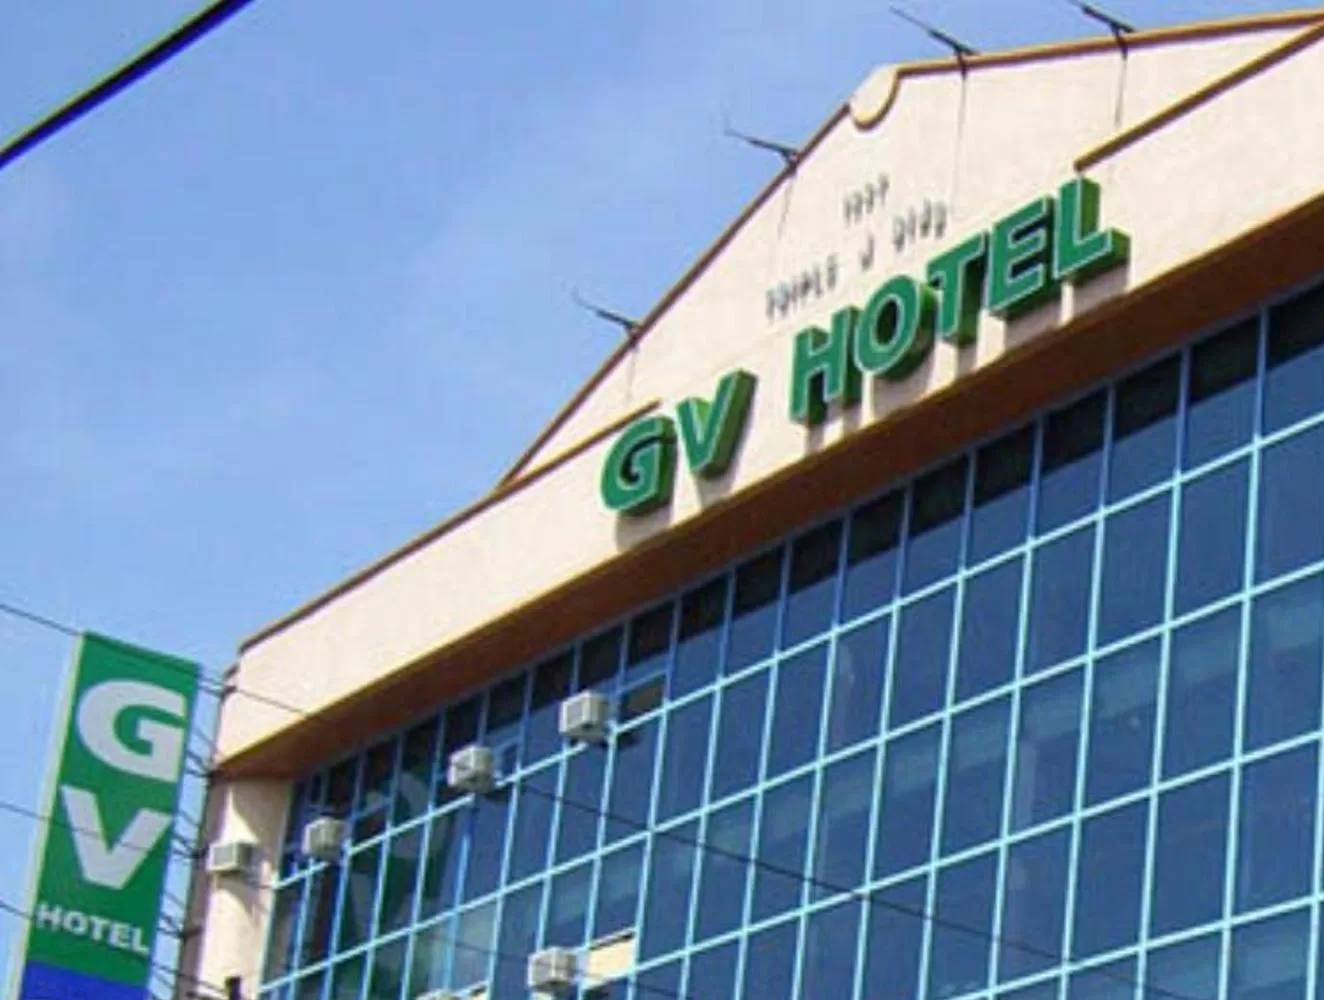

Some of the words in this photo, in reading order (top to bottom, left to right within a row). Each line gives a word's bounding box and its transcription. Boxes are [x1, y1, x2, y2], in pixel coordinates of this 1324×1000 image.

[600, 368, 758, 516] GV
[788, 176, 1131, 428] HOTEL
[36, 902, 151, 955] HOTEL
